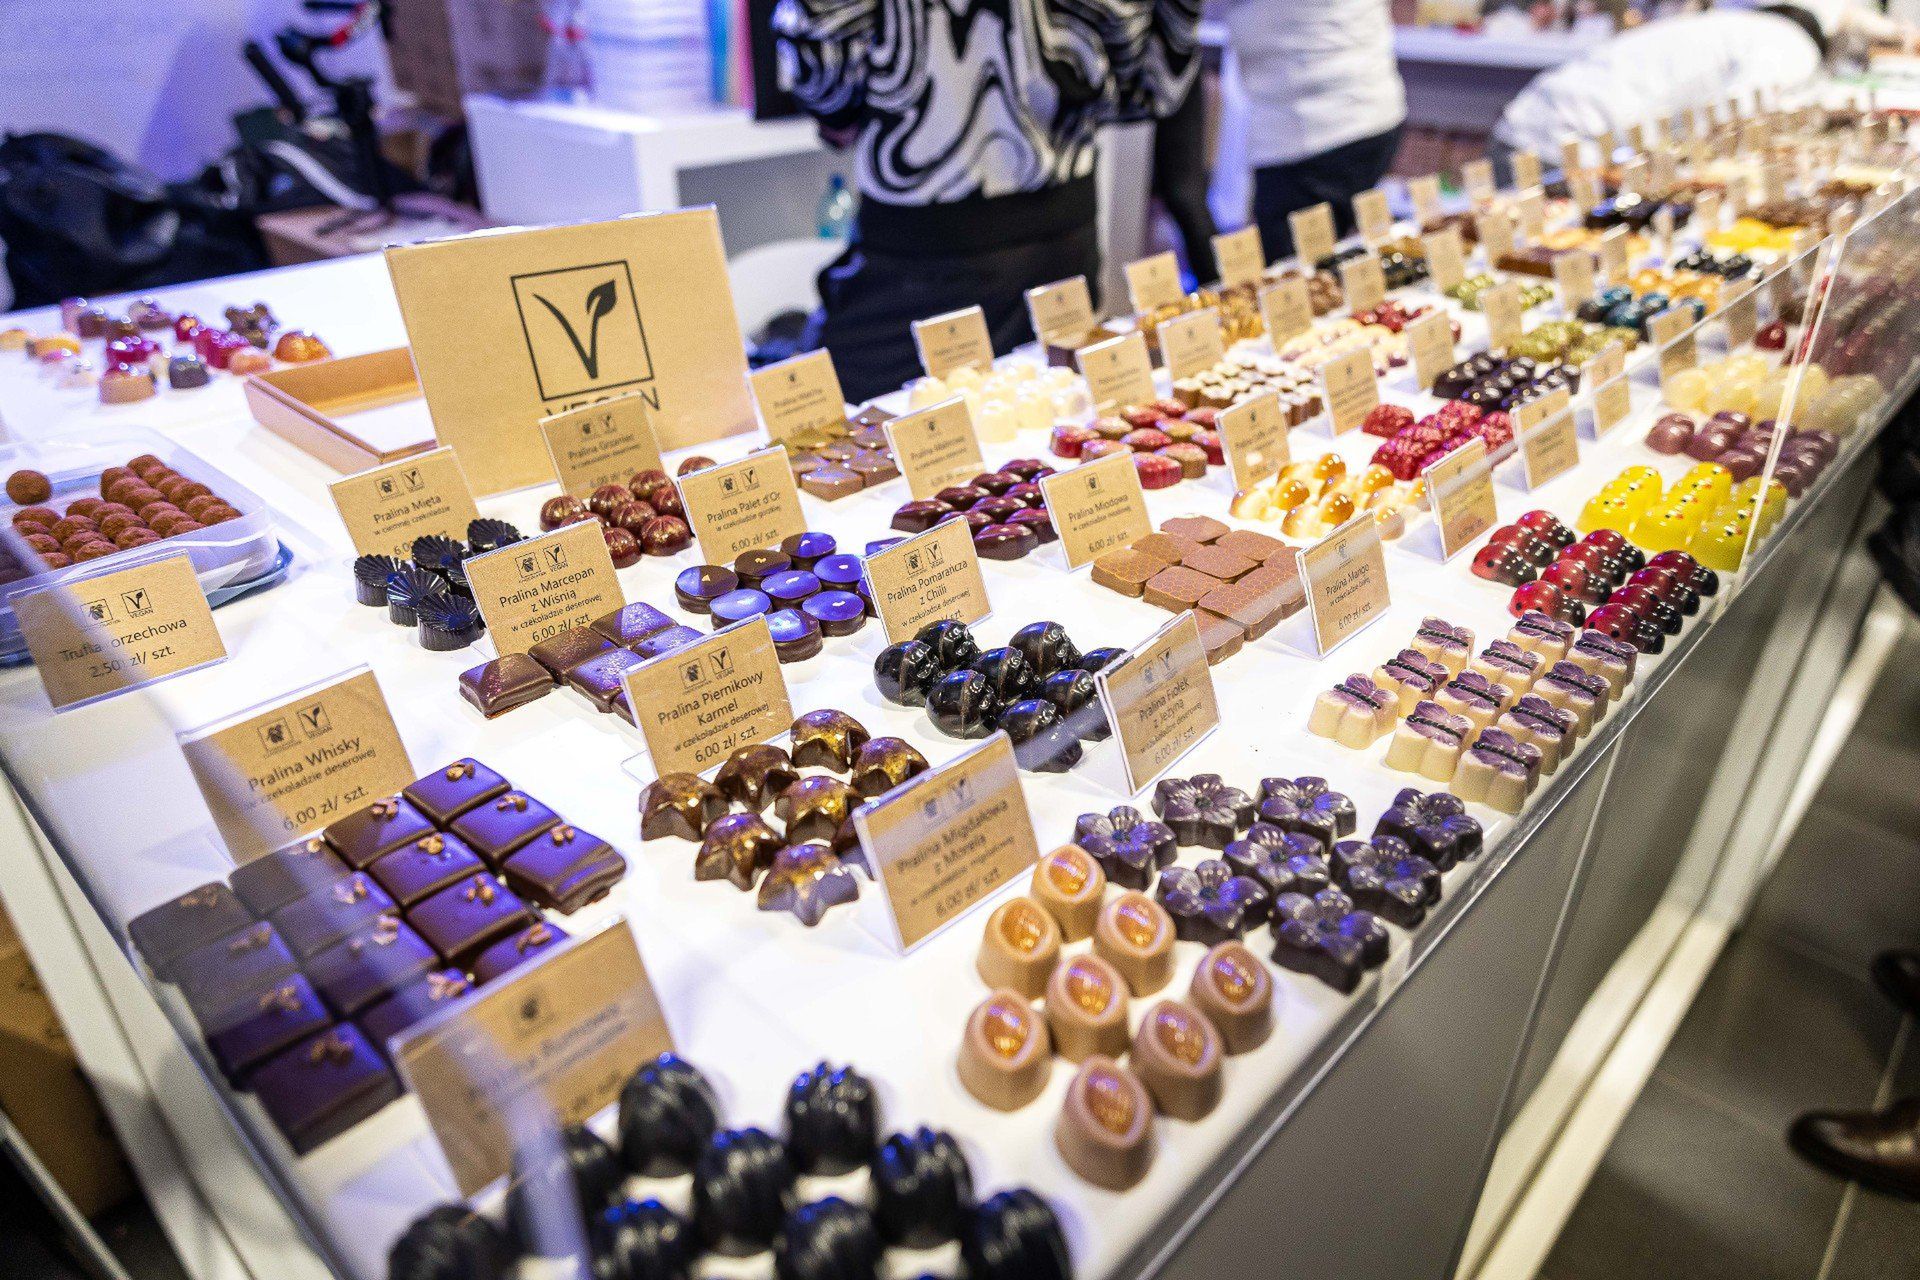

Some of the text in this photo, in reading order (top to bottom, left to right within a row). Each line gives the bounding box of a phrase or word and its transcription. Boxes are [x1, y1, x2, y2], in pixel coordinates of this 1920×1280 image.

[373, 506, 410, 523] Pralina
[411, 495, 442, 511] Mięta
[706, 507, 738, 524] Pralina
[739, 499, 760, 513] Palet
[1068, 507, 1095, 523] Pralina
[499, 586, 539, 608] Pralina
[541, 567, 595, 594] Marcepan
[887, 584, 918, 604] Pralina
[918, 560, 969, 589] Pomarańcza
[1325, 577, 1349, 596] Pralina
[129, 608, 154, 619] VEGAN
[511, 593, 603, 632] w czekoladzie deserowej
[531, 589, 578, 613] z Wiśnią
[919, 596, 926, 606] z
[110, 618, 187, 648] orzechowa
[532, 624, 556, 643] 6,00
[901, 620, 909, 628] w
[129, 651, 147, 668] zł/
[151, 645, 176, 660] szt.
[657, 699, 701, 726] Pralina
[701, 670, 764, 706] Piernikowy
[697, 697, 739, 727] Karmel
[1139, 696, 1167, 722] Pralina
[682, 721, 730, 750] czekoladzie
[730, 702, 770, 725] deserowej
[694, 725, 760, 764] 6,00 zł/ szt.
[248, 761, 304, 792] Pralina
[304, 737, 361, 767] Whisky
[324, 747, 377, 777] deserowej
[320, 795, 339, 816] zł/
[344, 785, 370, 804] szt.
